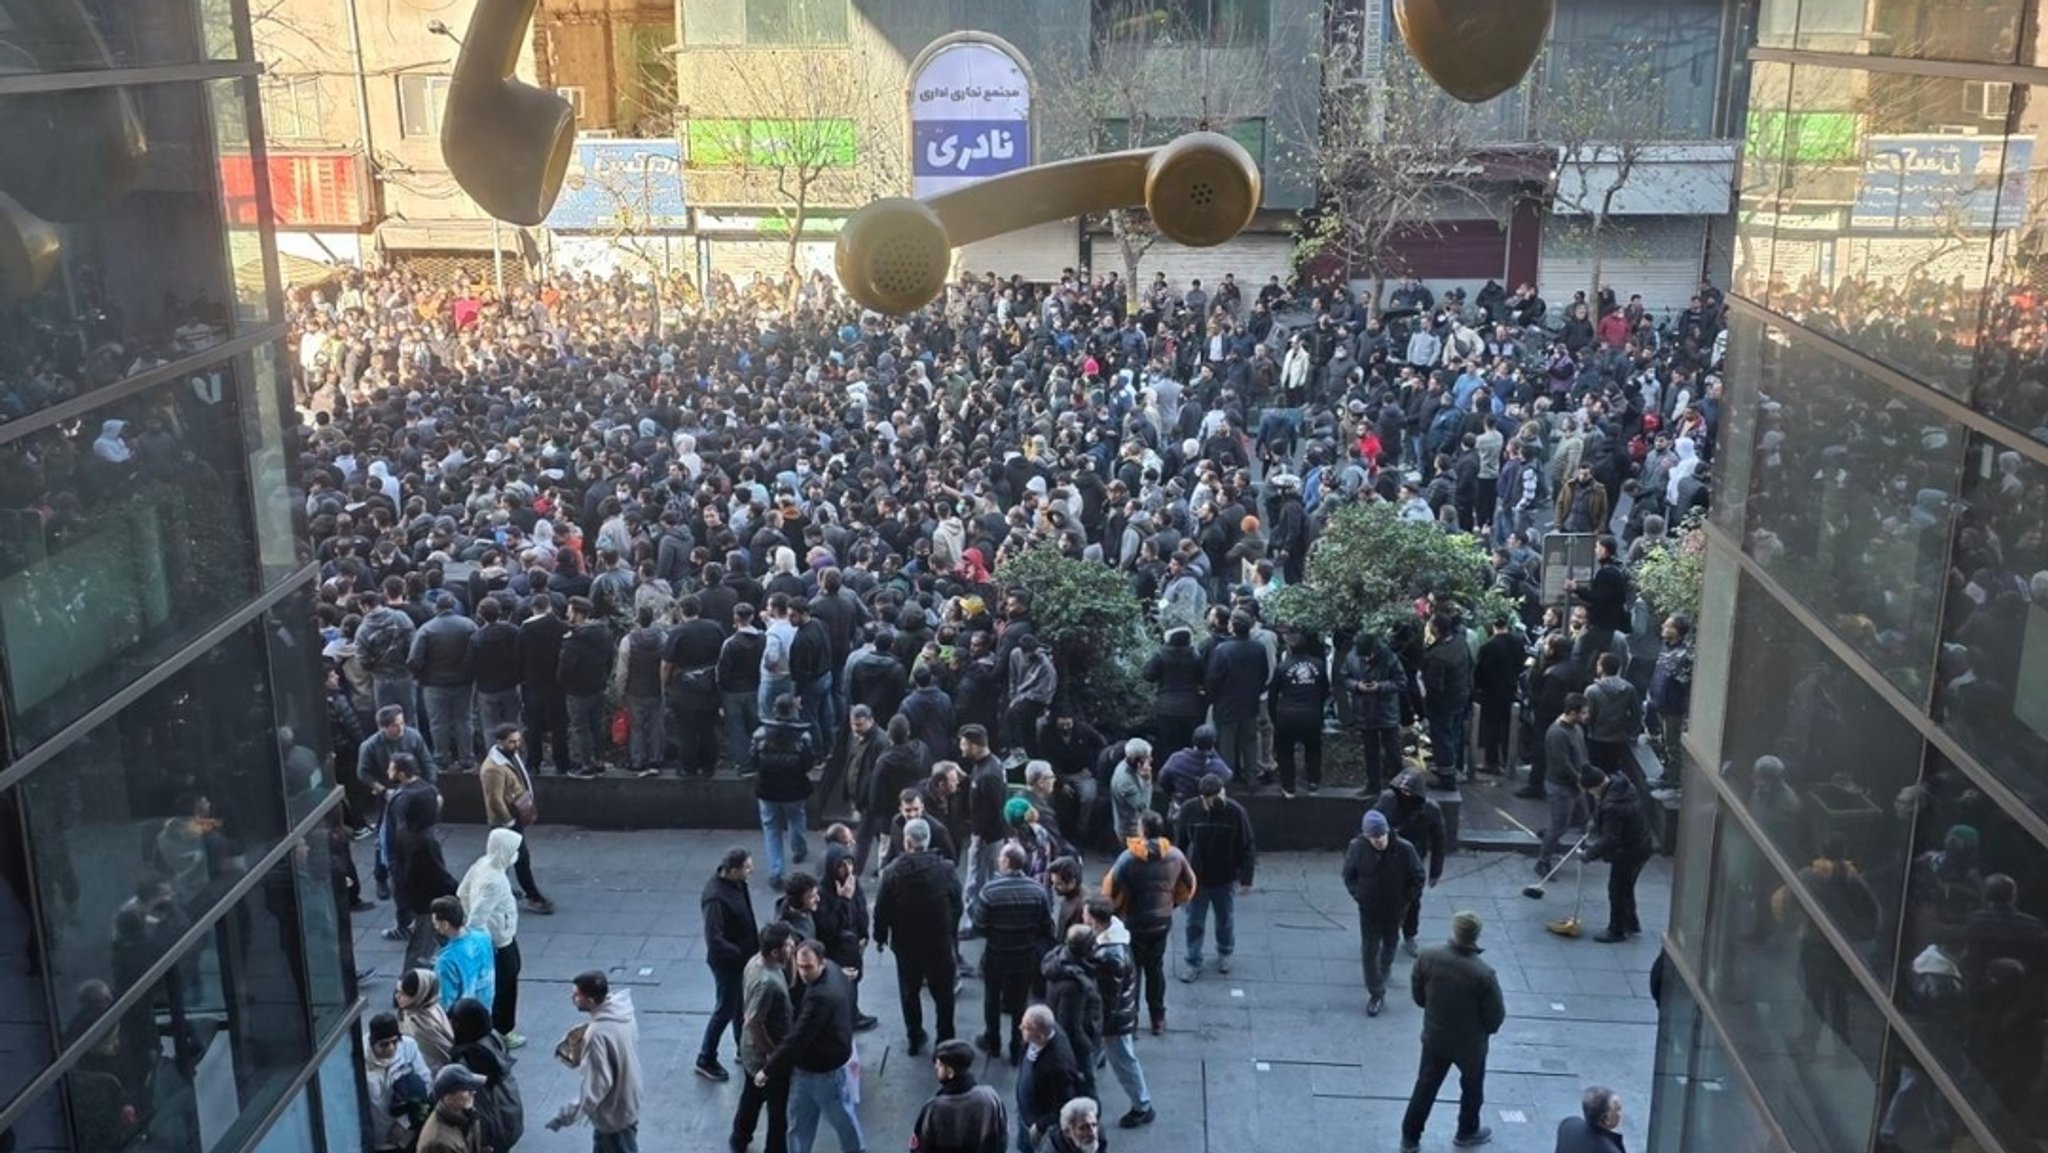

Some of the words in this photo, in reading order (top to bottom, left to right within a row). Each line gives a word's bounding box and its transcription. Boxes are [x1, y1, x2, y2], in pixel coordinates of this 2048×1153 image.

[919, 86, 949, 102] اداری
[983, 86, 1019, 102] مجتمع
[926, 129, 1014, 171] نادری
